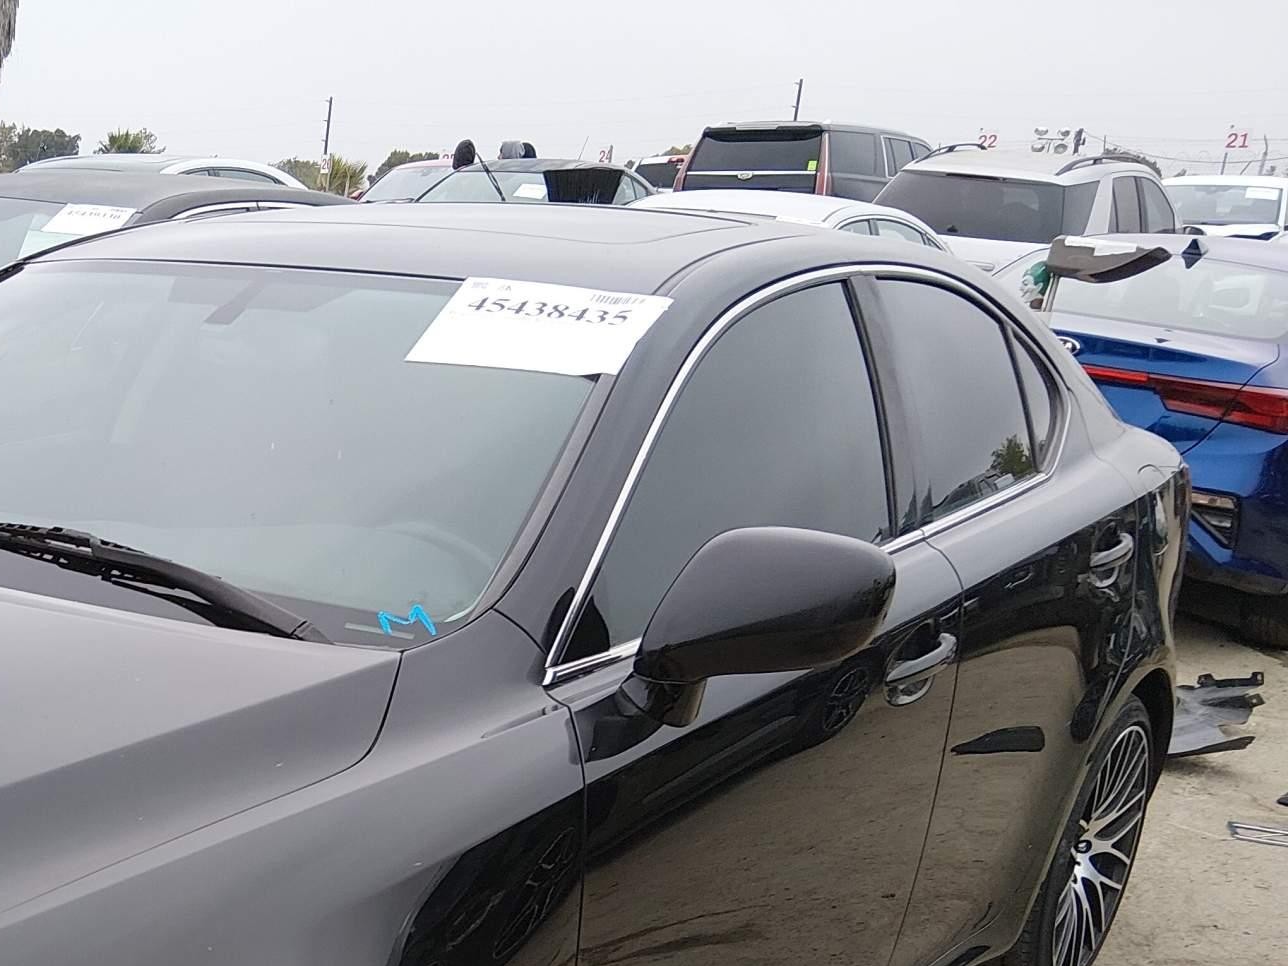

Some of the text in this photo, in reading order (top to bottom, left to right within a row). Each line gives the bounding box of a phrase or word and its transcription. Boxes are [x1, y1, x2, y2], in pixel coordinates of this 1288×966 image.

[978, 134, 998, 148] 22
[1225, 132, 1249, 149] 21
[467, 296, 632, 326] 45438435
[377, 603, 437, 636] M
